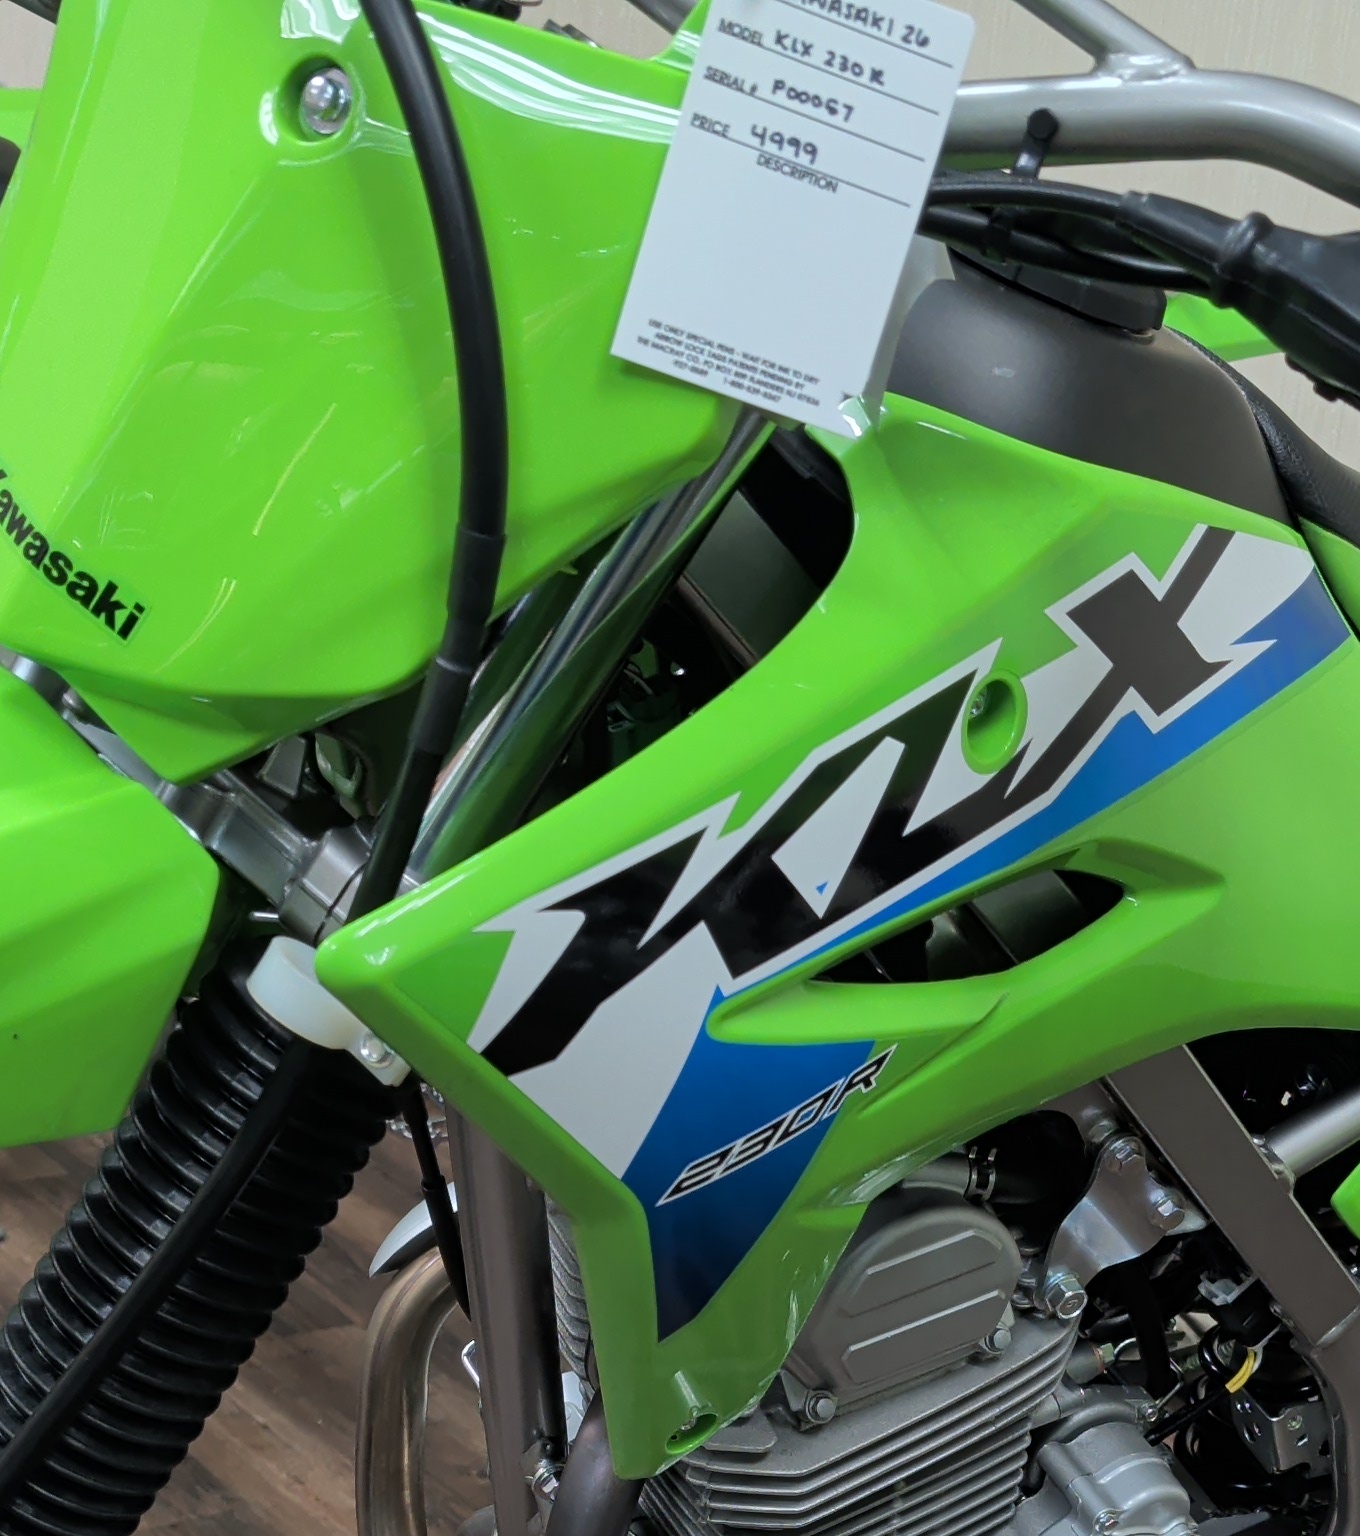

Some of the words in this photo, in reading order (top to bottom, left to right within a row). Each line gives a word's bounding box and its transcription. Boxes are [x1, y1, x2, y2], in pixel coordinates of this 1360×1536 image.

[717, 17, 763, 48] MODEL
[774, 30, 814, 58] KLX
[823, 50, 864, 77] 230
[901, 24, 930, 48] 26
[703, 66, 746, 93] SERIAL
[690, 113, 731, 138] PRICE
[750, 123, 819, 165] 4999
[756, 152, 839, 193] DESCRIPTION
[478, 524, 1240, 1078] KLX
[656, 1043, 898, 1207] 230R
